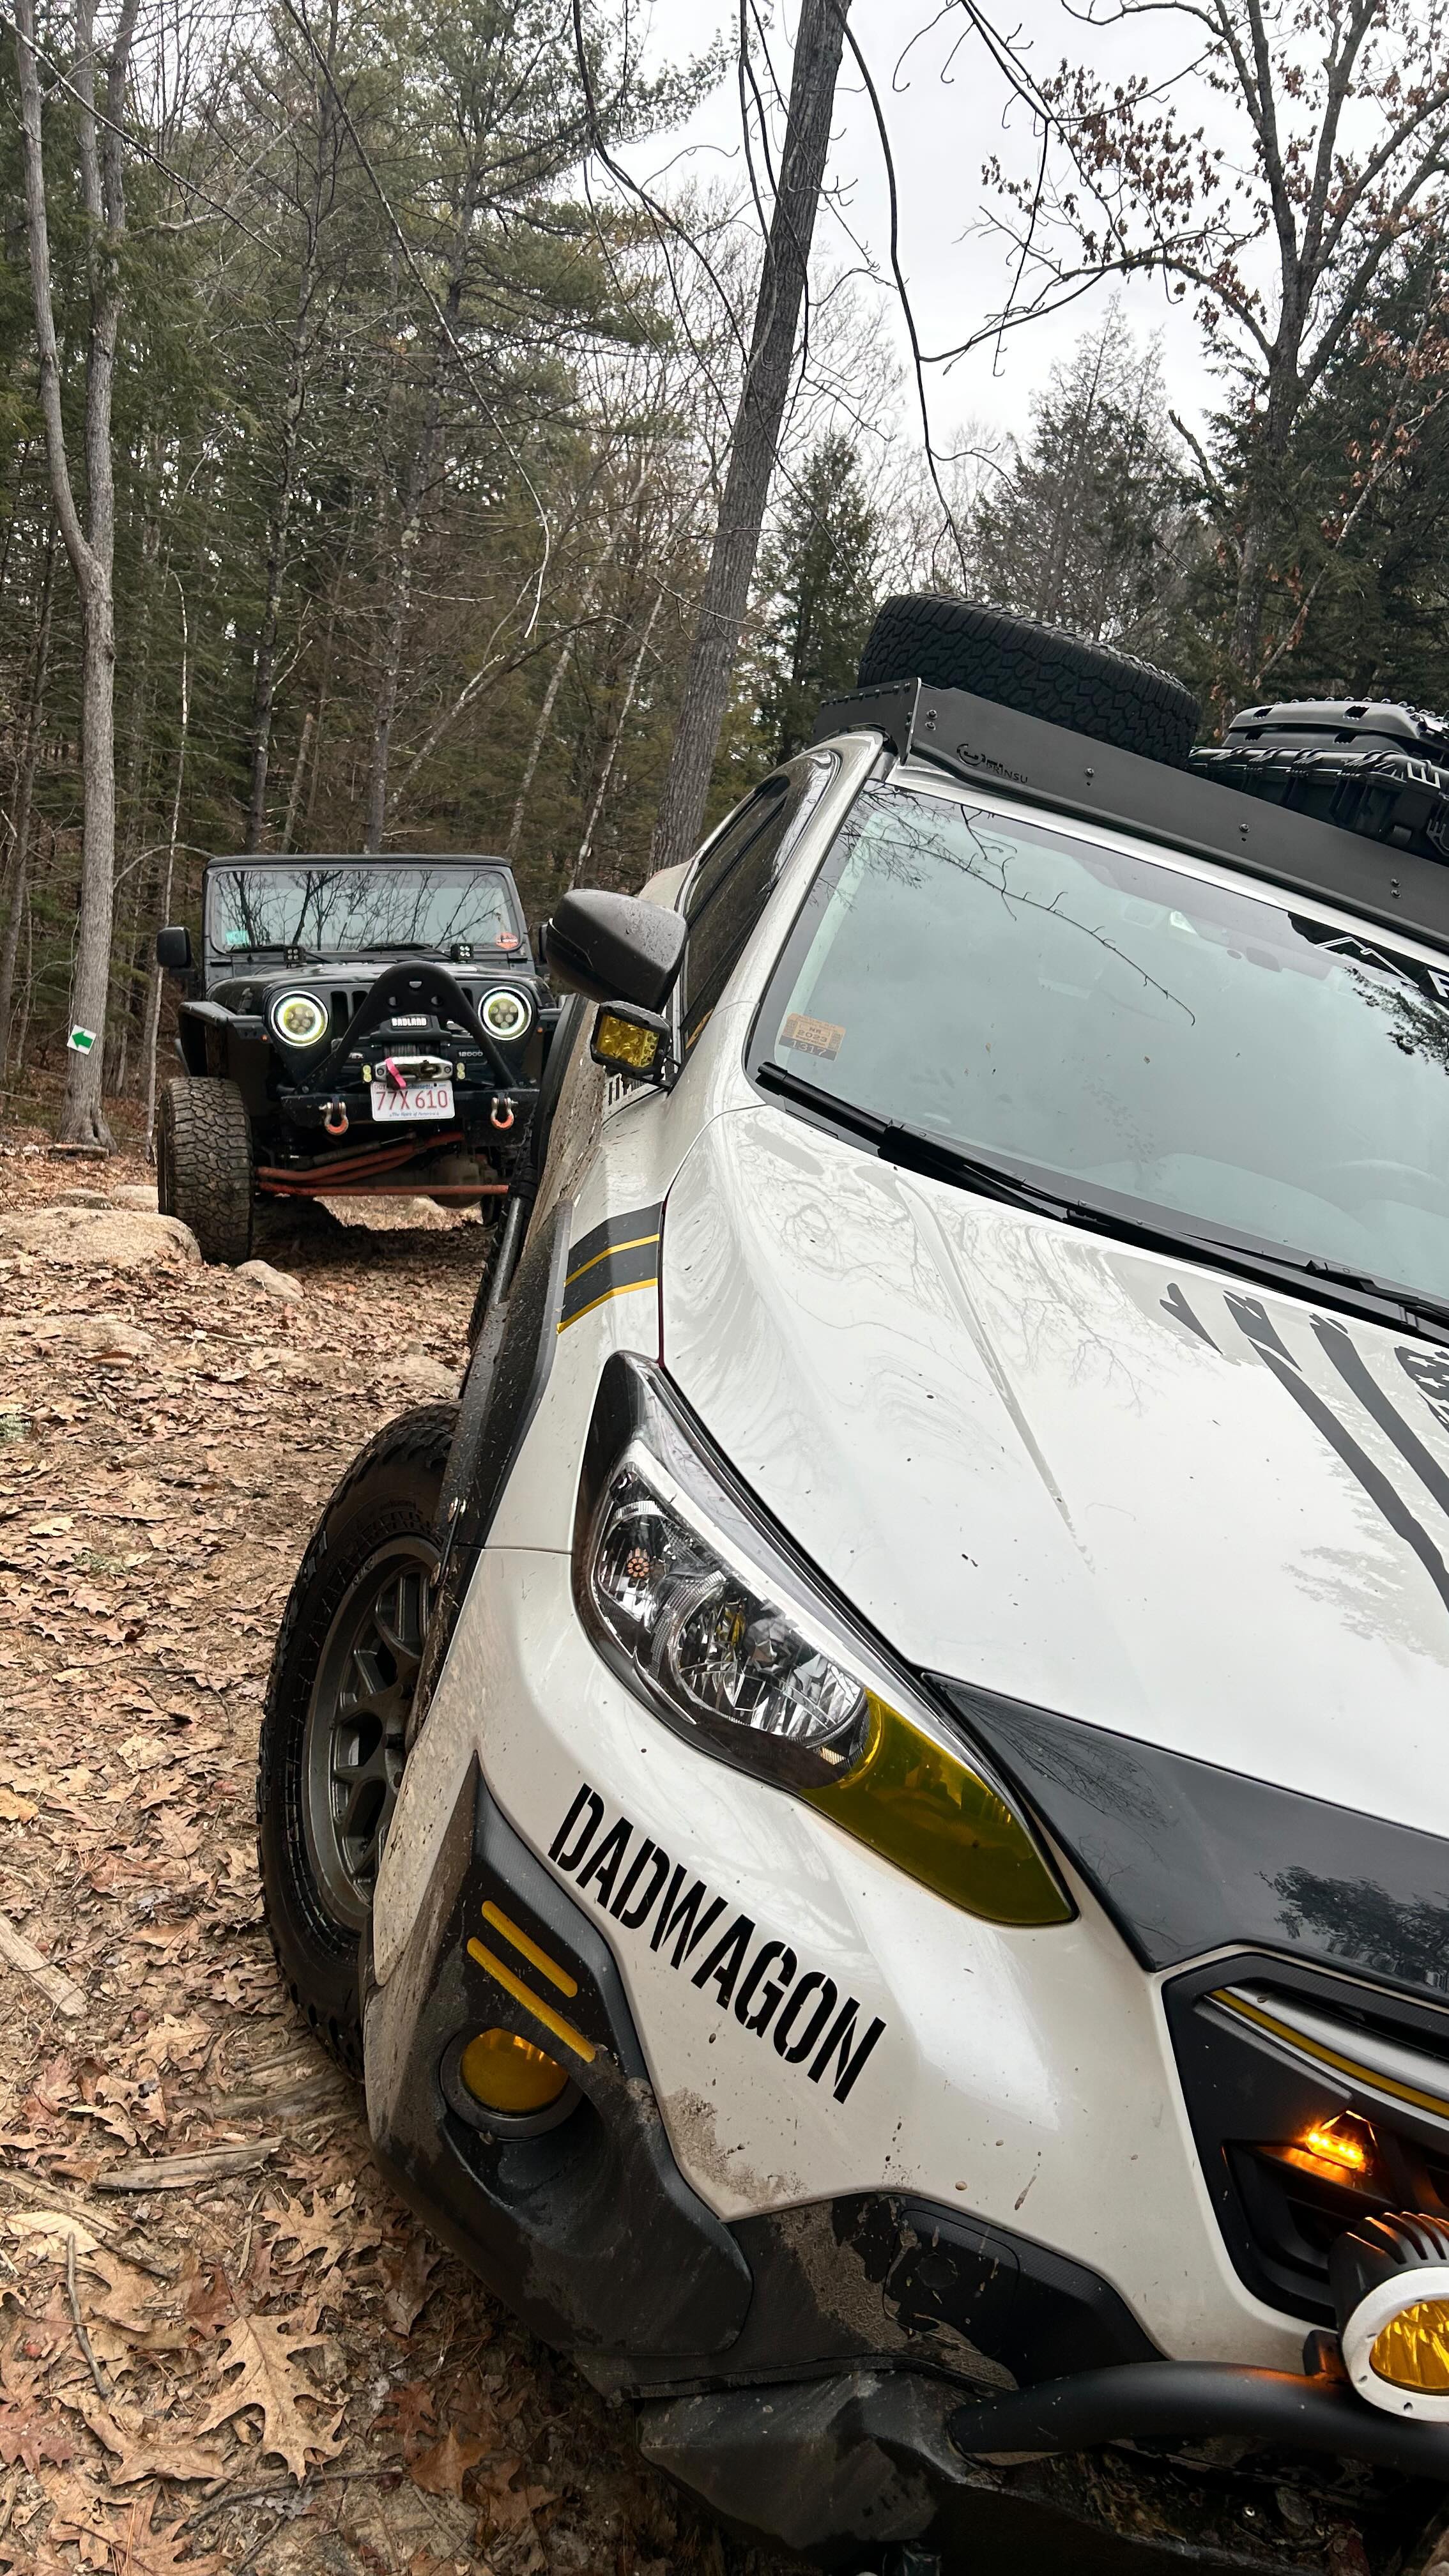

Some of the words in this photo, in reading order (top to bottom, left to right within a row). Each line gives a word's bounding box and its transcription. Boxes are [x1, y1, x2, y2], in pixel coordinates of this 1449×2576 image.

[392, 1018, 427, 1026] BADLAND
[792, 1040, 827, 1055] 1317
[376, 1091, 410, 1110] 77X
[415, 1090, 448, 1108] 610
[548, 1782, 887, 2104] DADWAGON
